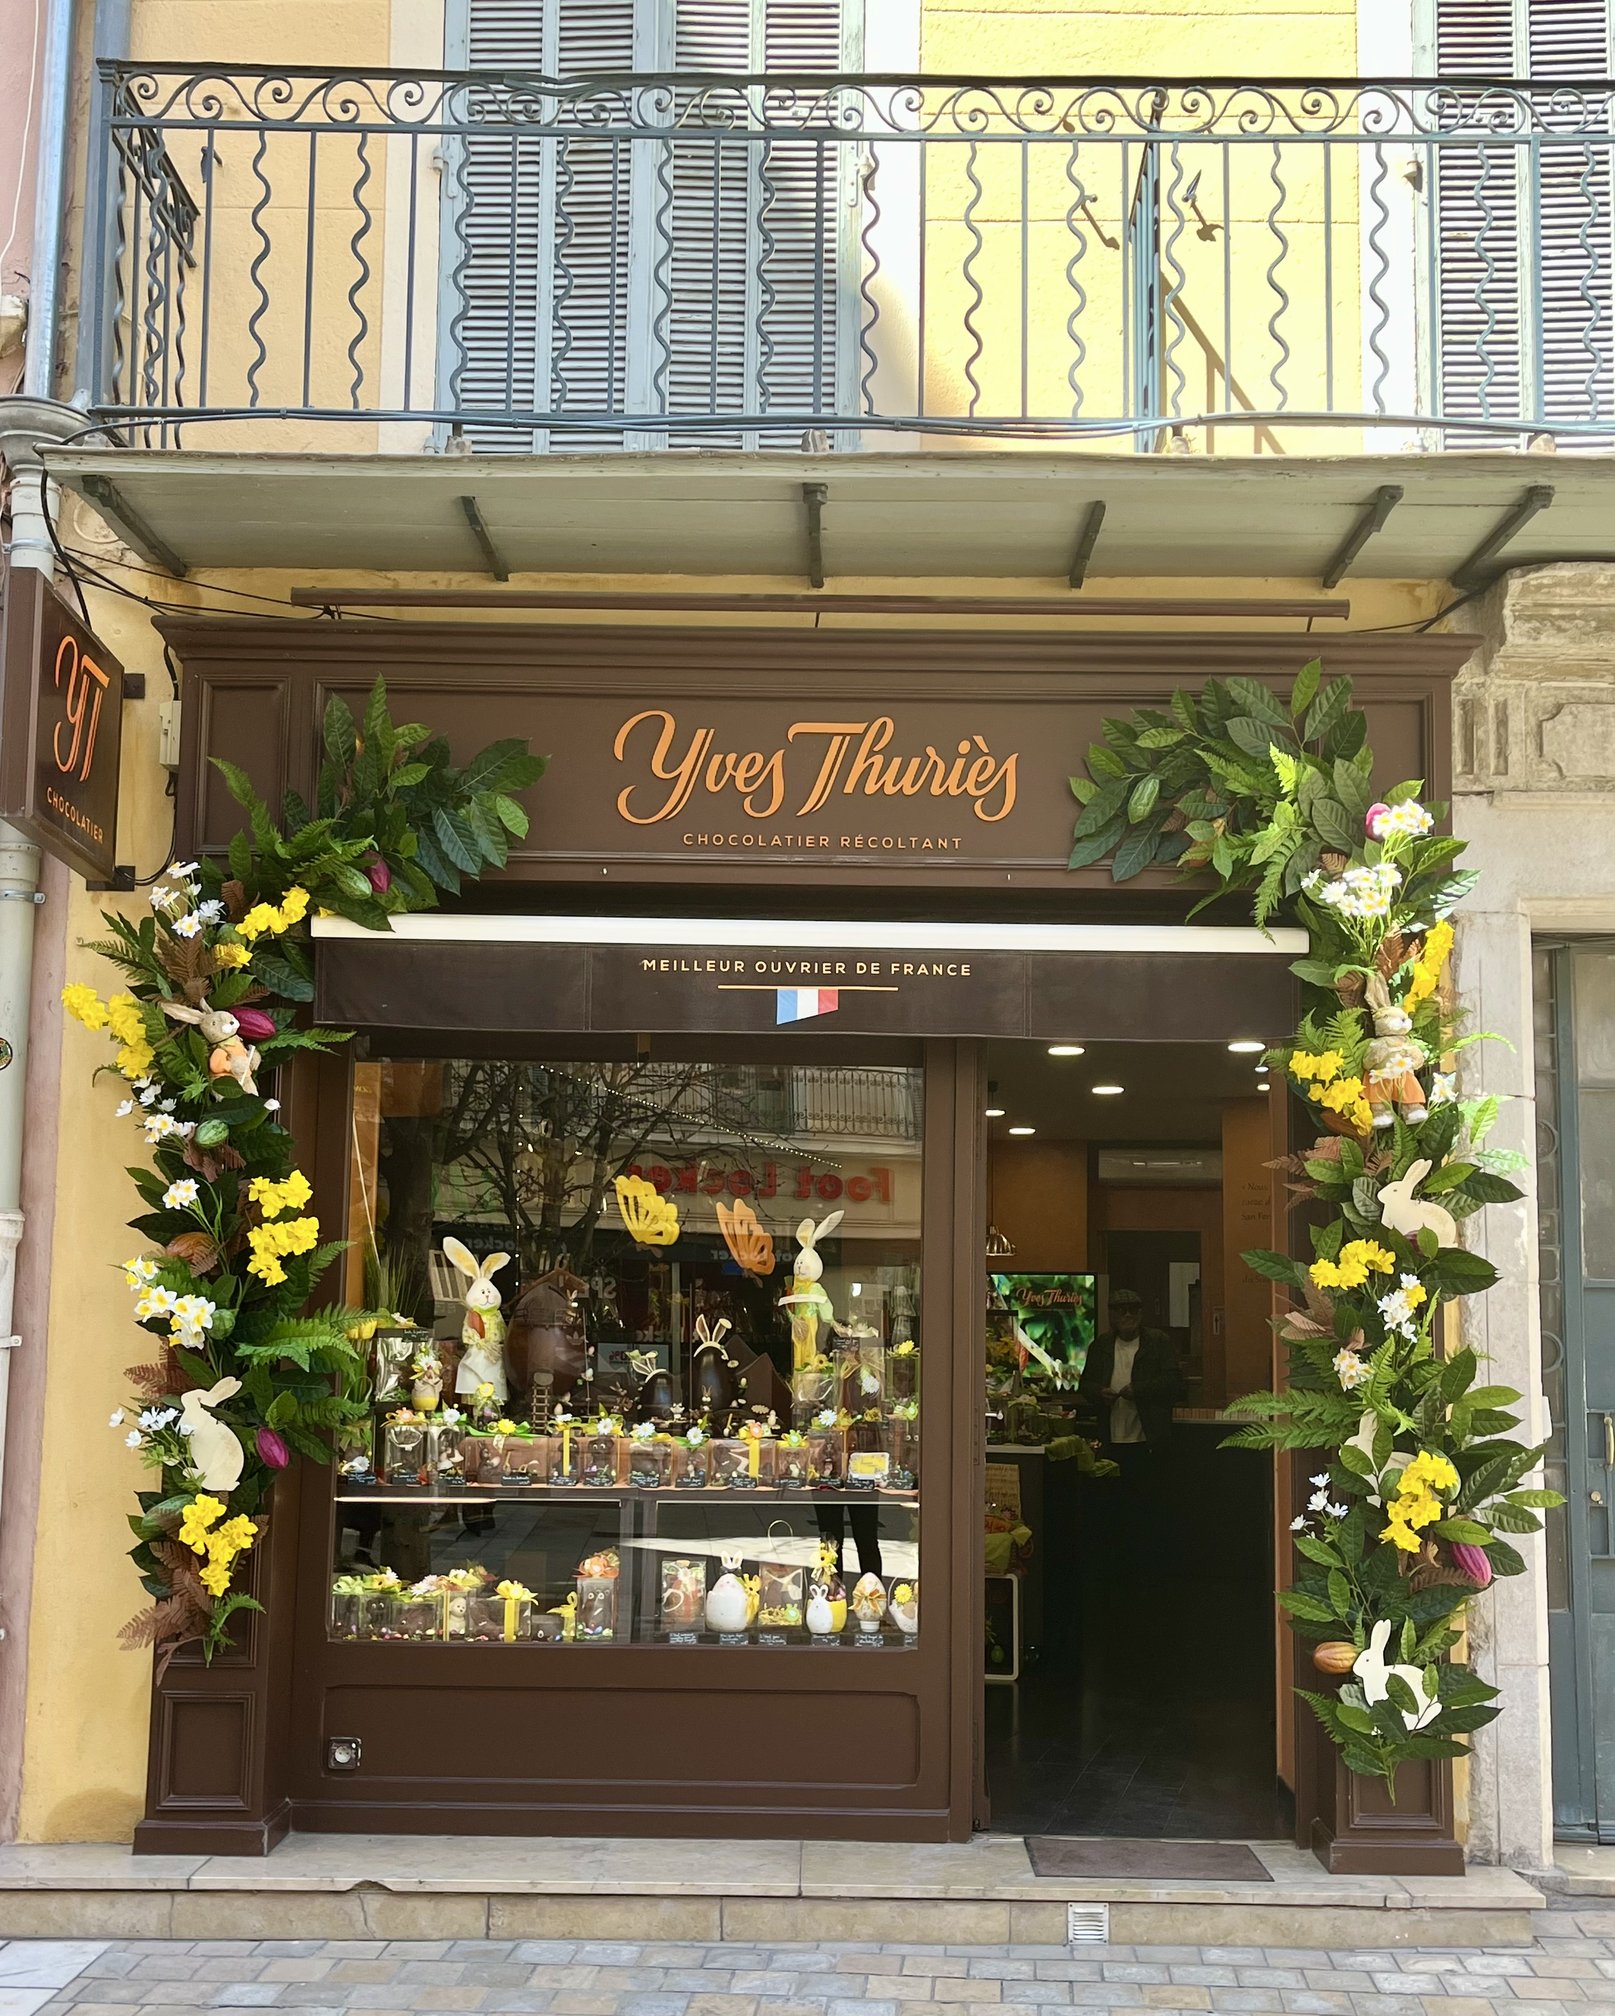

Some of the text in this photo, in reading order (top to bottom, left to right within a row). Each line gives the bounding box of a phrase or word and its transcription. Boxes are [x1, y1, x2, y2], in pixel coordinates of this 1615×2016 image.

[613, 709, 1019, 824] Yves Thuriès
[46, 786, 103, 844] CHOCOLATIER
[682, 832, 963, 850] CHOCOLATIER RÉCOLTANT
[643, 959, 972, 976] MEILLEUR OUVRIER DE FRANCE
